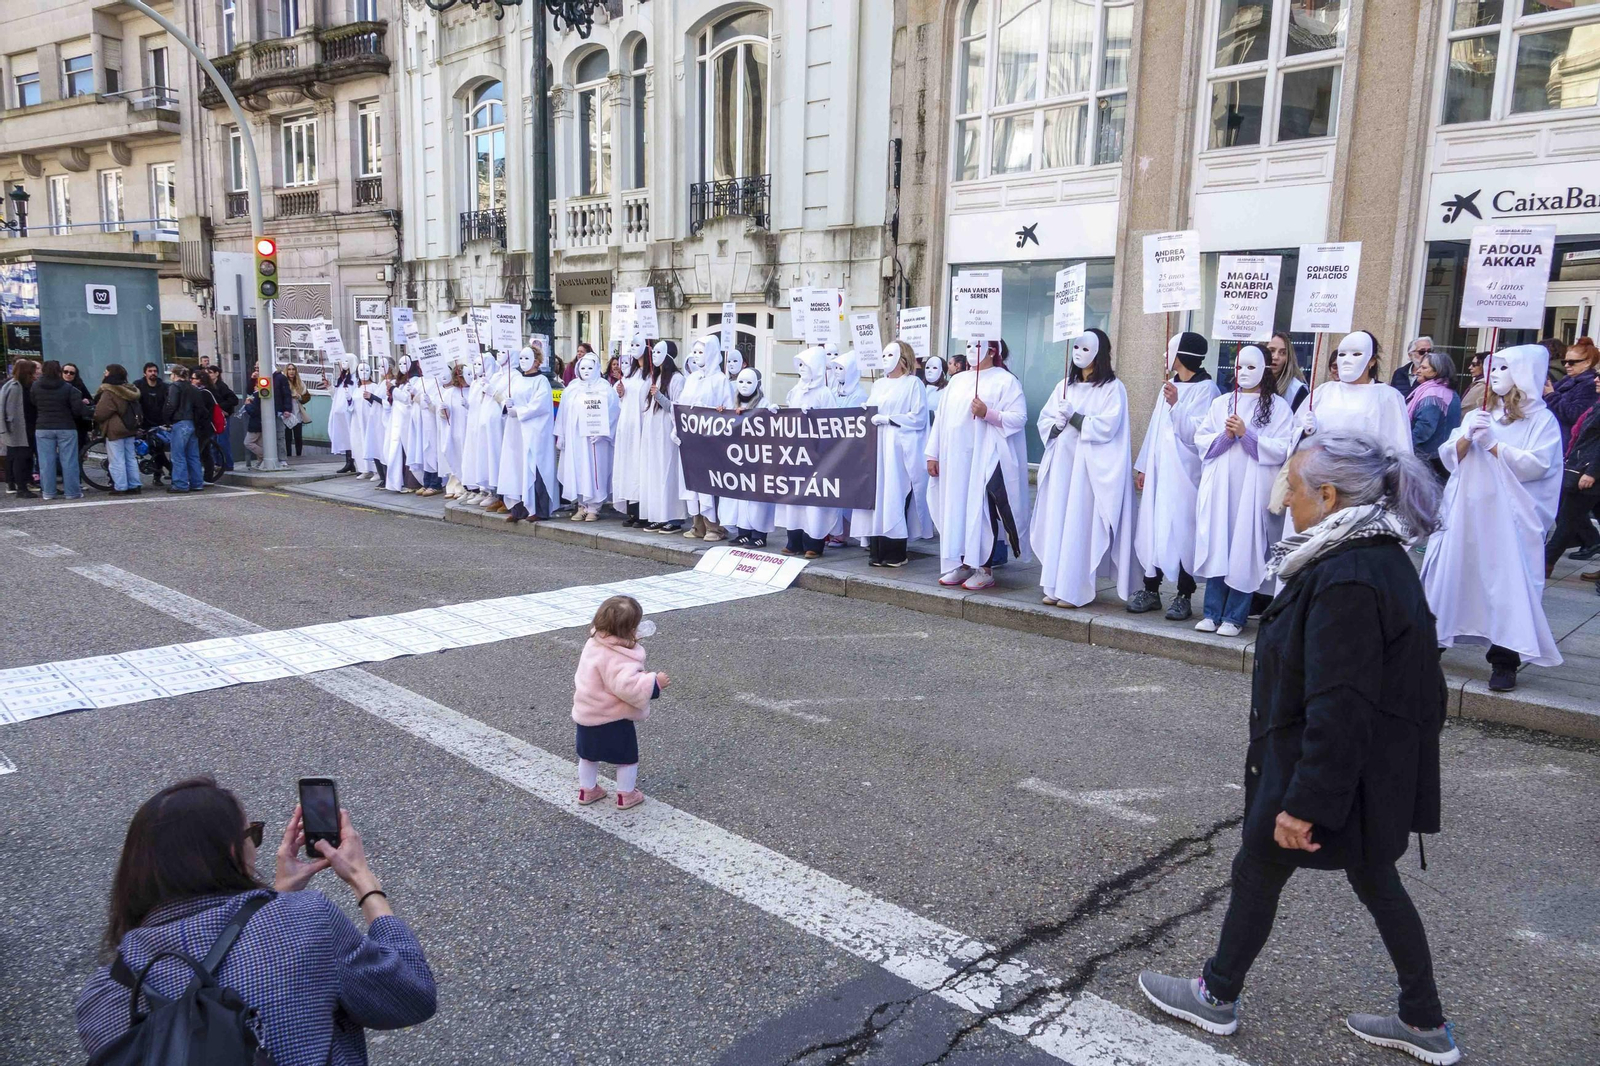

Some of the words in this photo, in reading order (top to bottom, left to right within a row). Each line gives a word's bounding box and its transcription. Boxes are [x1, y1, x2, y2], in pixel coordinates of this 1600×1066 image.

[1492, 186, 1600, 213] CaixaBa
[1155, 249, 1185, 257] ANDREA
[1478, 244, 1542, 254] FADOUA
[1156, 255, 1185, 263] YTURRY
[1482, 256, 1536, 267] AKKAR
[1227, 272, 1269, 280] MAGALI
[1220, 282, 1273, 290] SANABRIA
[1486, 282, 1498, 290] 41
[1224, 291, 1268, 299] ROMERO
[439, 326, 460, 337] MARITZA
[680, 412, 736, 436] SOMOS
[741, 416, 766, 437] AS
[770, 416, 867, 439] MULLERES
[726, 443, 773, 466] QUE
[778, 446, 813, 466] XA
[708, 470, 756, 492] NON
[763, 472, 840, 498] ESTÁN
[729, 549, 785, 565] FEMINICIDIOS
[736, 564, 756, 573] 2025
